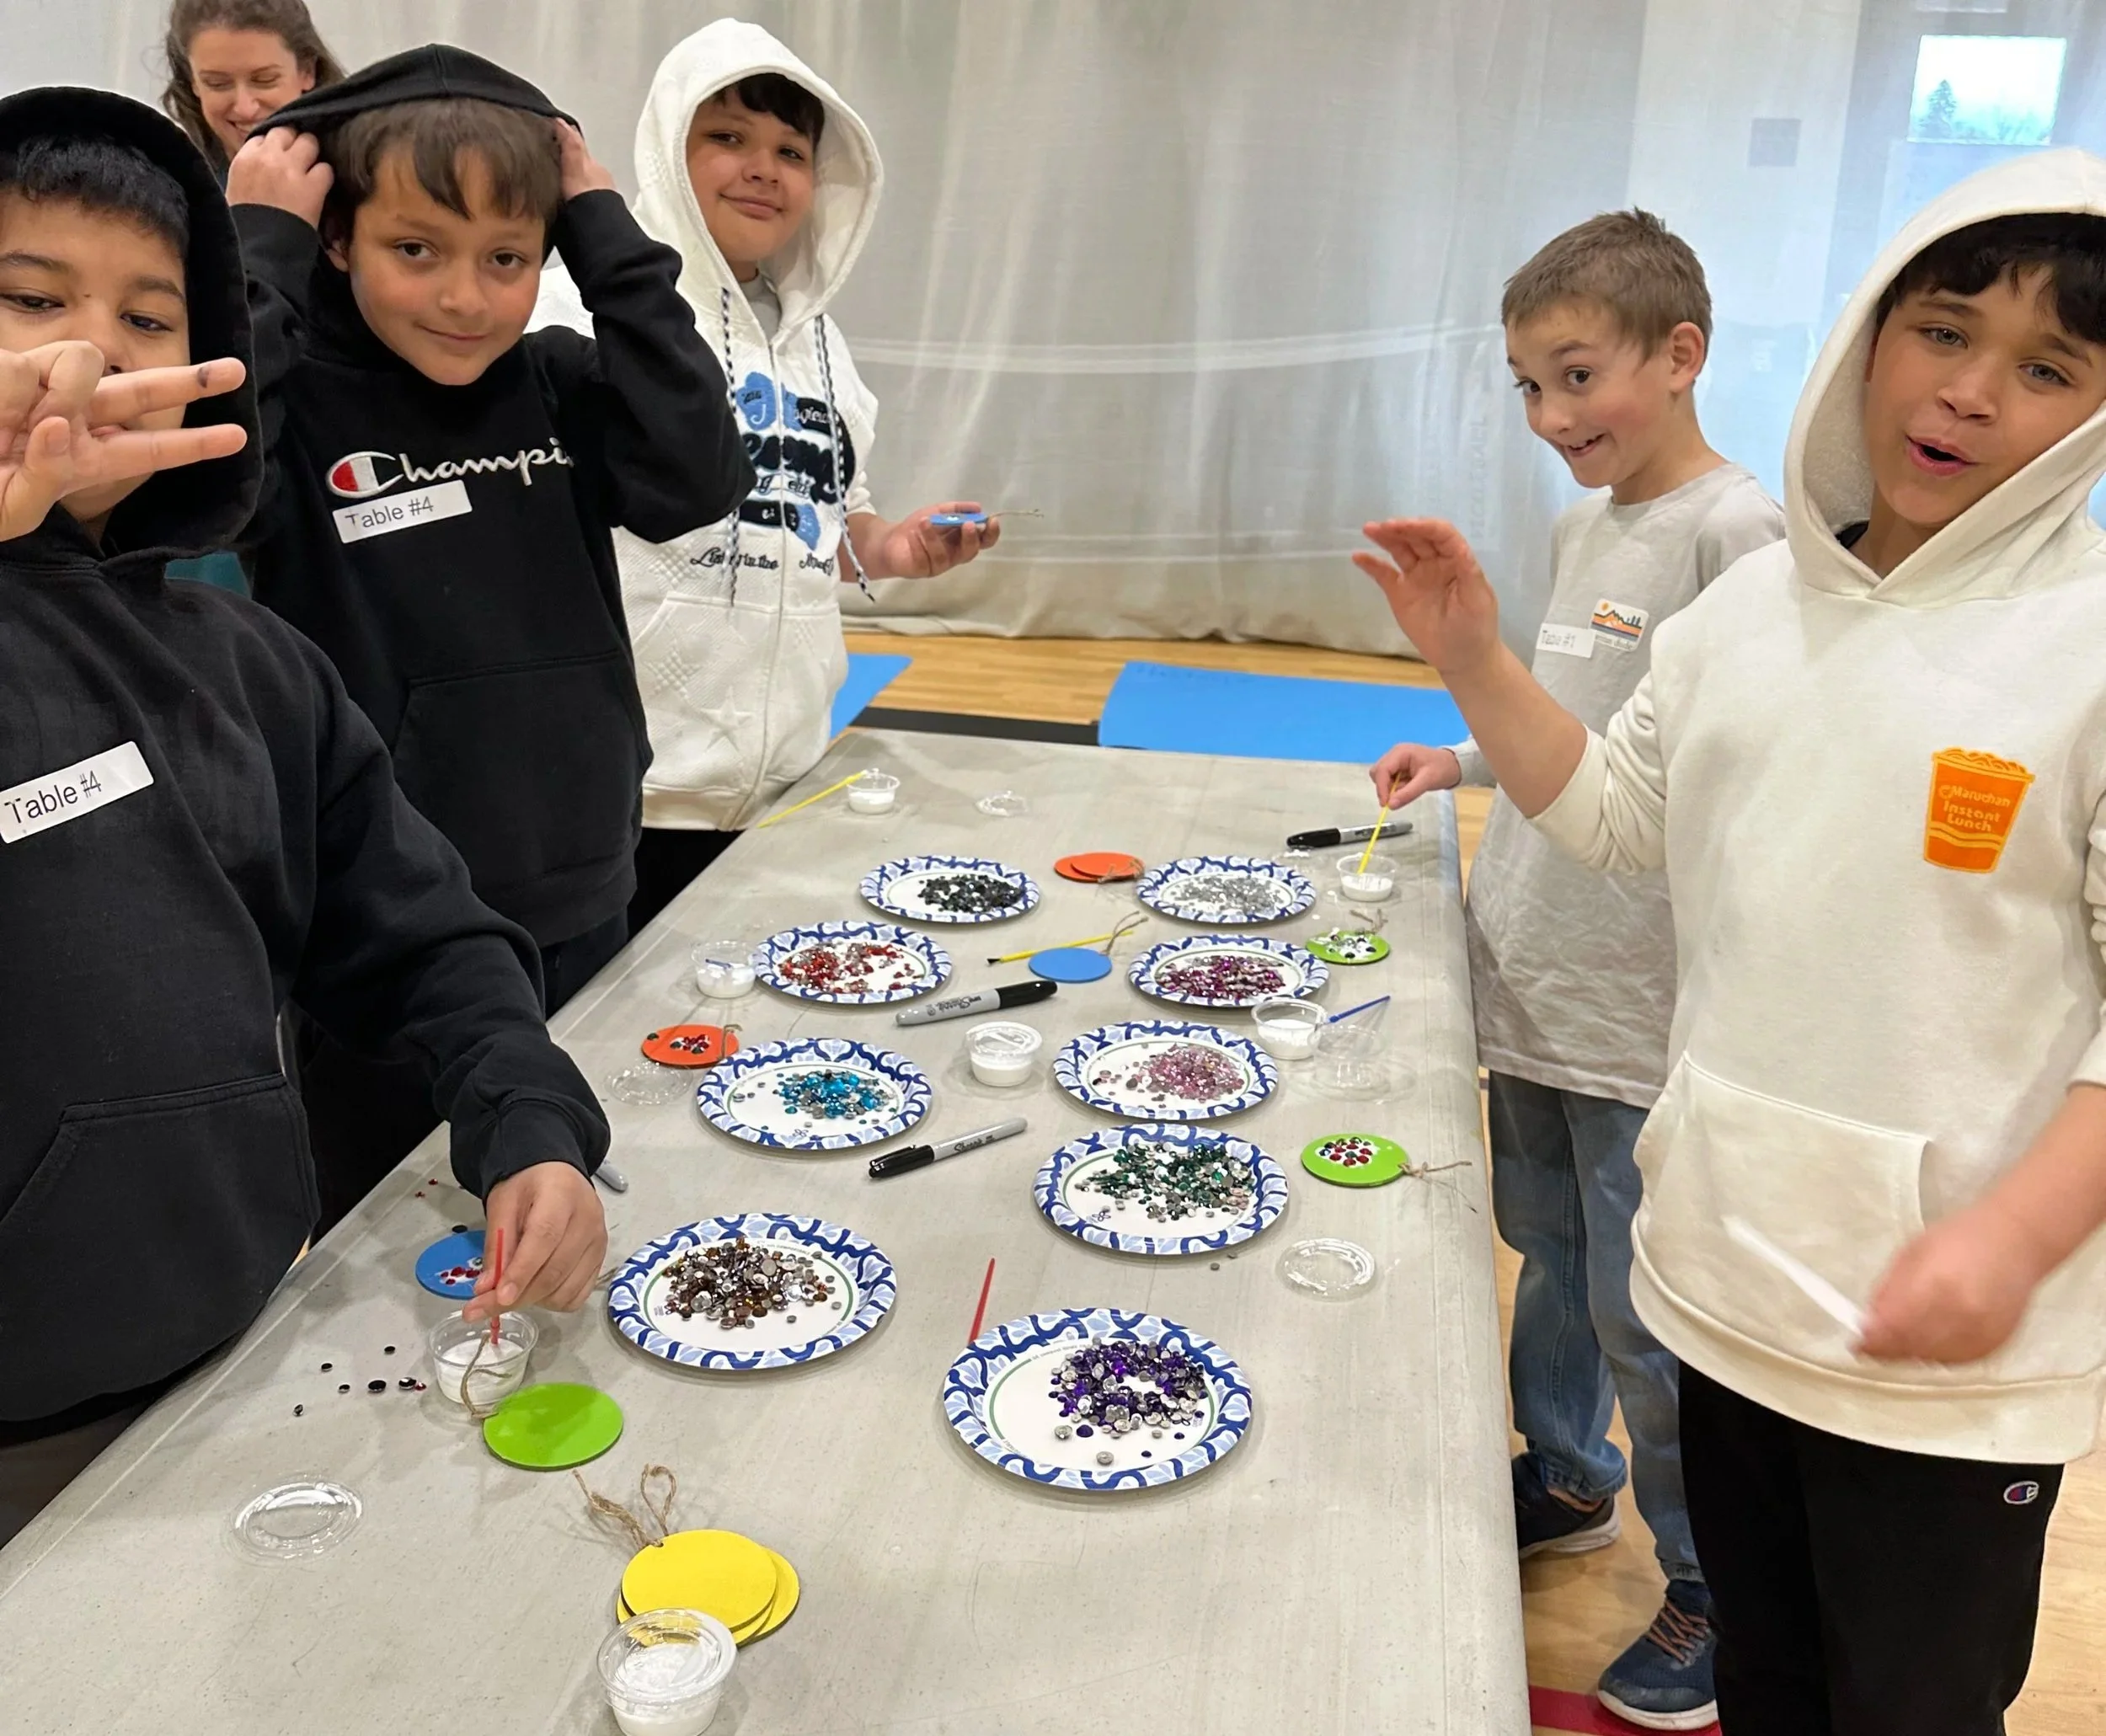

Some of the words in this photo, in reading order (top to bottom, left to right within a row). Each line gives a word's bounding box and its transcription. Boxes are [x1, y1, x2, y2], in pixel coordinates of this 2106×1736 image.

[325, 436, 575, 499] Champi
[345, 505, 404, 529] Table
[407, 495, 435, 516] #4
[3, 784, 79, 824] Table
[79, 770, 102, 799] #4
[1952, 785, 2012, 808] Maruchan
[1943, 800, 2002, 823] Instant
[1947, 814, 1992, 832] Lunch
